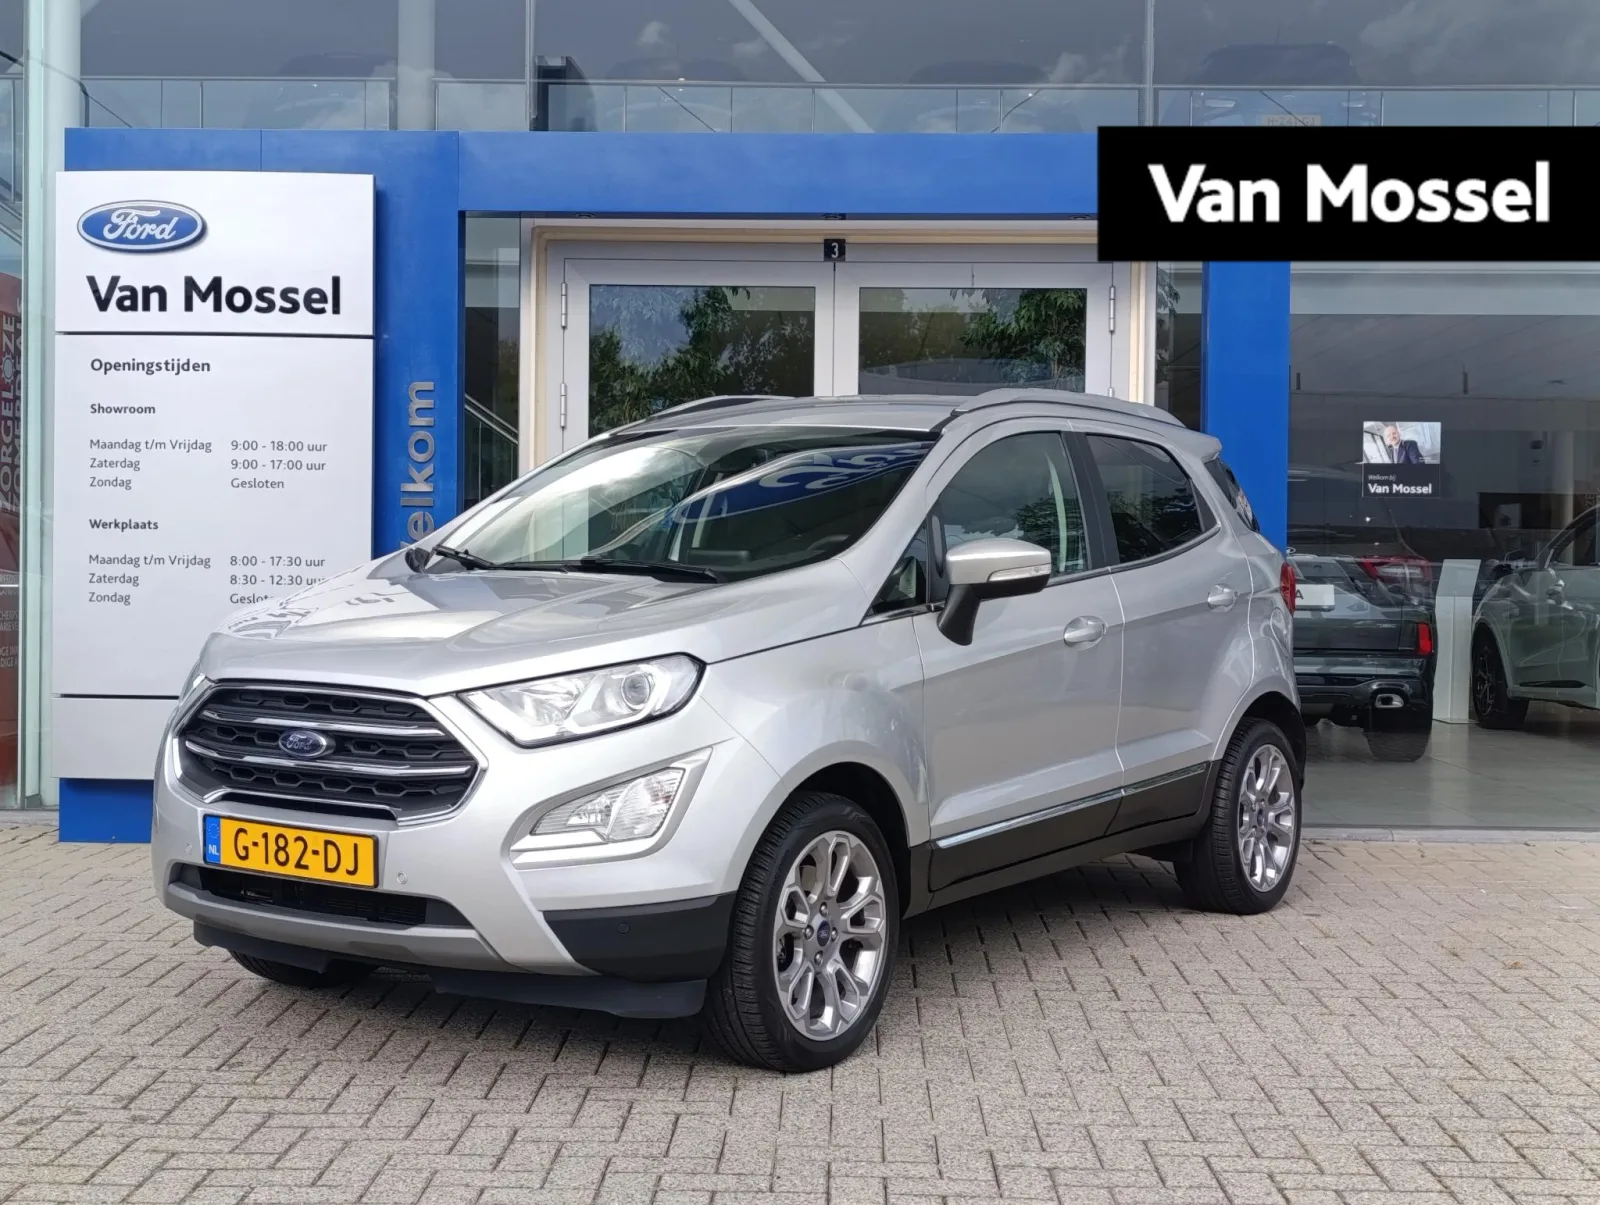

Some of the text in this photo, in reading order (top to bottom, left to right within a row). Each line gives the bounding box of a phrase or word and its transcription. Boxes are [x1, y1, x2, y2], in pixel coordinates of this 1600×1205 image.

[103, 208, 177, 240] Ford
[831, 242, 839, 258] 3
[86, 275, 341, 315] Van Mossel
[90, 358, 211, 375] Openingstijden
[90, 403, 156, 414] Showroom
[90, 439, 142, 452] Maandag
[144, 439, 166, 450] t/m
[170, 440, 212, 453] Vrijdag
[231, 440, 259, 451] 9:00
[270, 441, 304, 452] 18:00
[307, 442, 328, 452] uur
[90, 458, 141, 471] Zaterdag
[231, 459, 258, 470] 9:00
[270, 460, 303, 470] 17:00
[306, 461, 327, 471] uur
[400, 381, 435, 548] elkom
[89, 476, 285, 490] Zondag Gesloten
[1368, 483, 1432, 494] Van Mossel
[89, 519, 159, 532] Werkplaats
[88, 554, 140, 568] Maandag
[143, 555, 165, 565] t/m
[168, 555, 211, 568] Vrijdag
[230, 556, 257, 567] 8:00
[270, 556, 302, 567] 17:30
[305, 558, 326, 567] uur
[88, 573, 139, 587] Zaterdag
[230, 575, 257, 585] 8:30
[269, 575, 303, 586] 12:30
[88, 592, 275, 605] Zondag Geslot
[286, 734, 313, 751] Ford
[208, 845, 219, 855] NL
[233, 827, 359, 876] G-182-DJ
